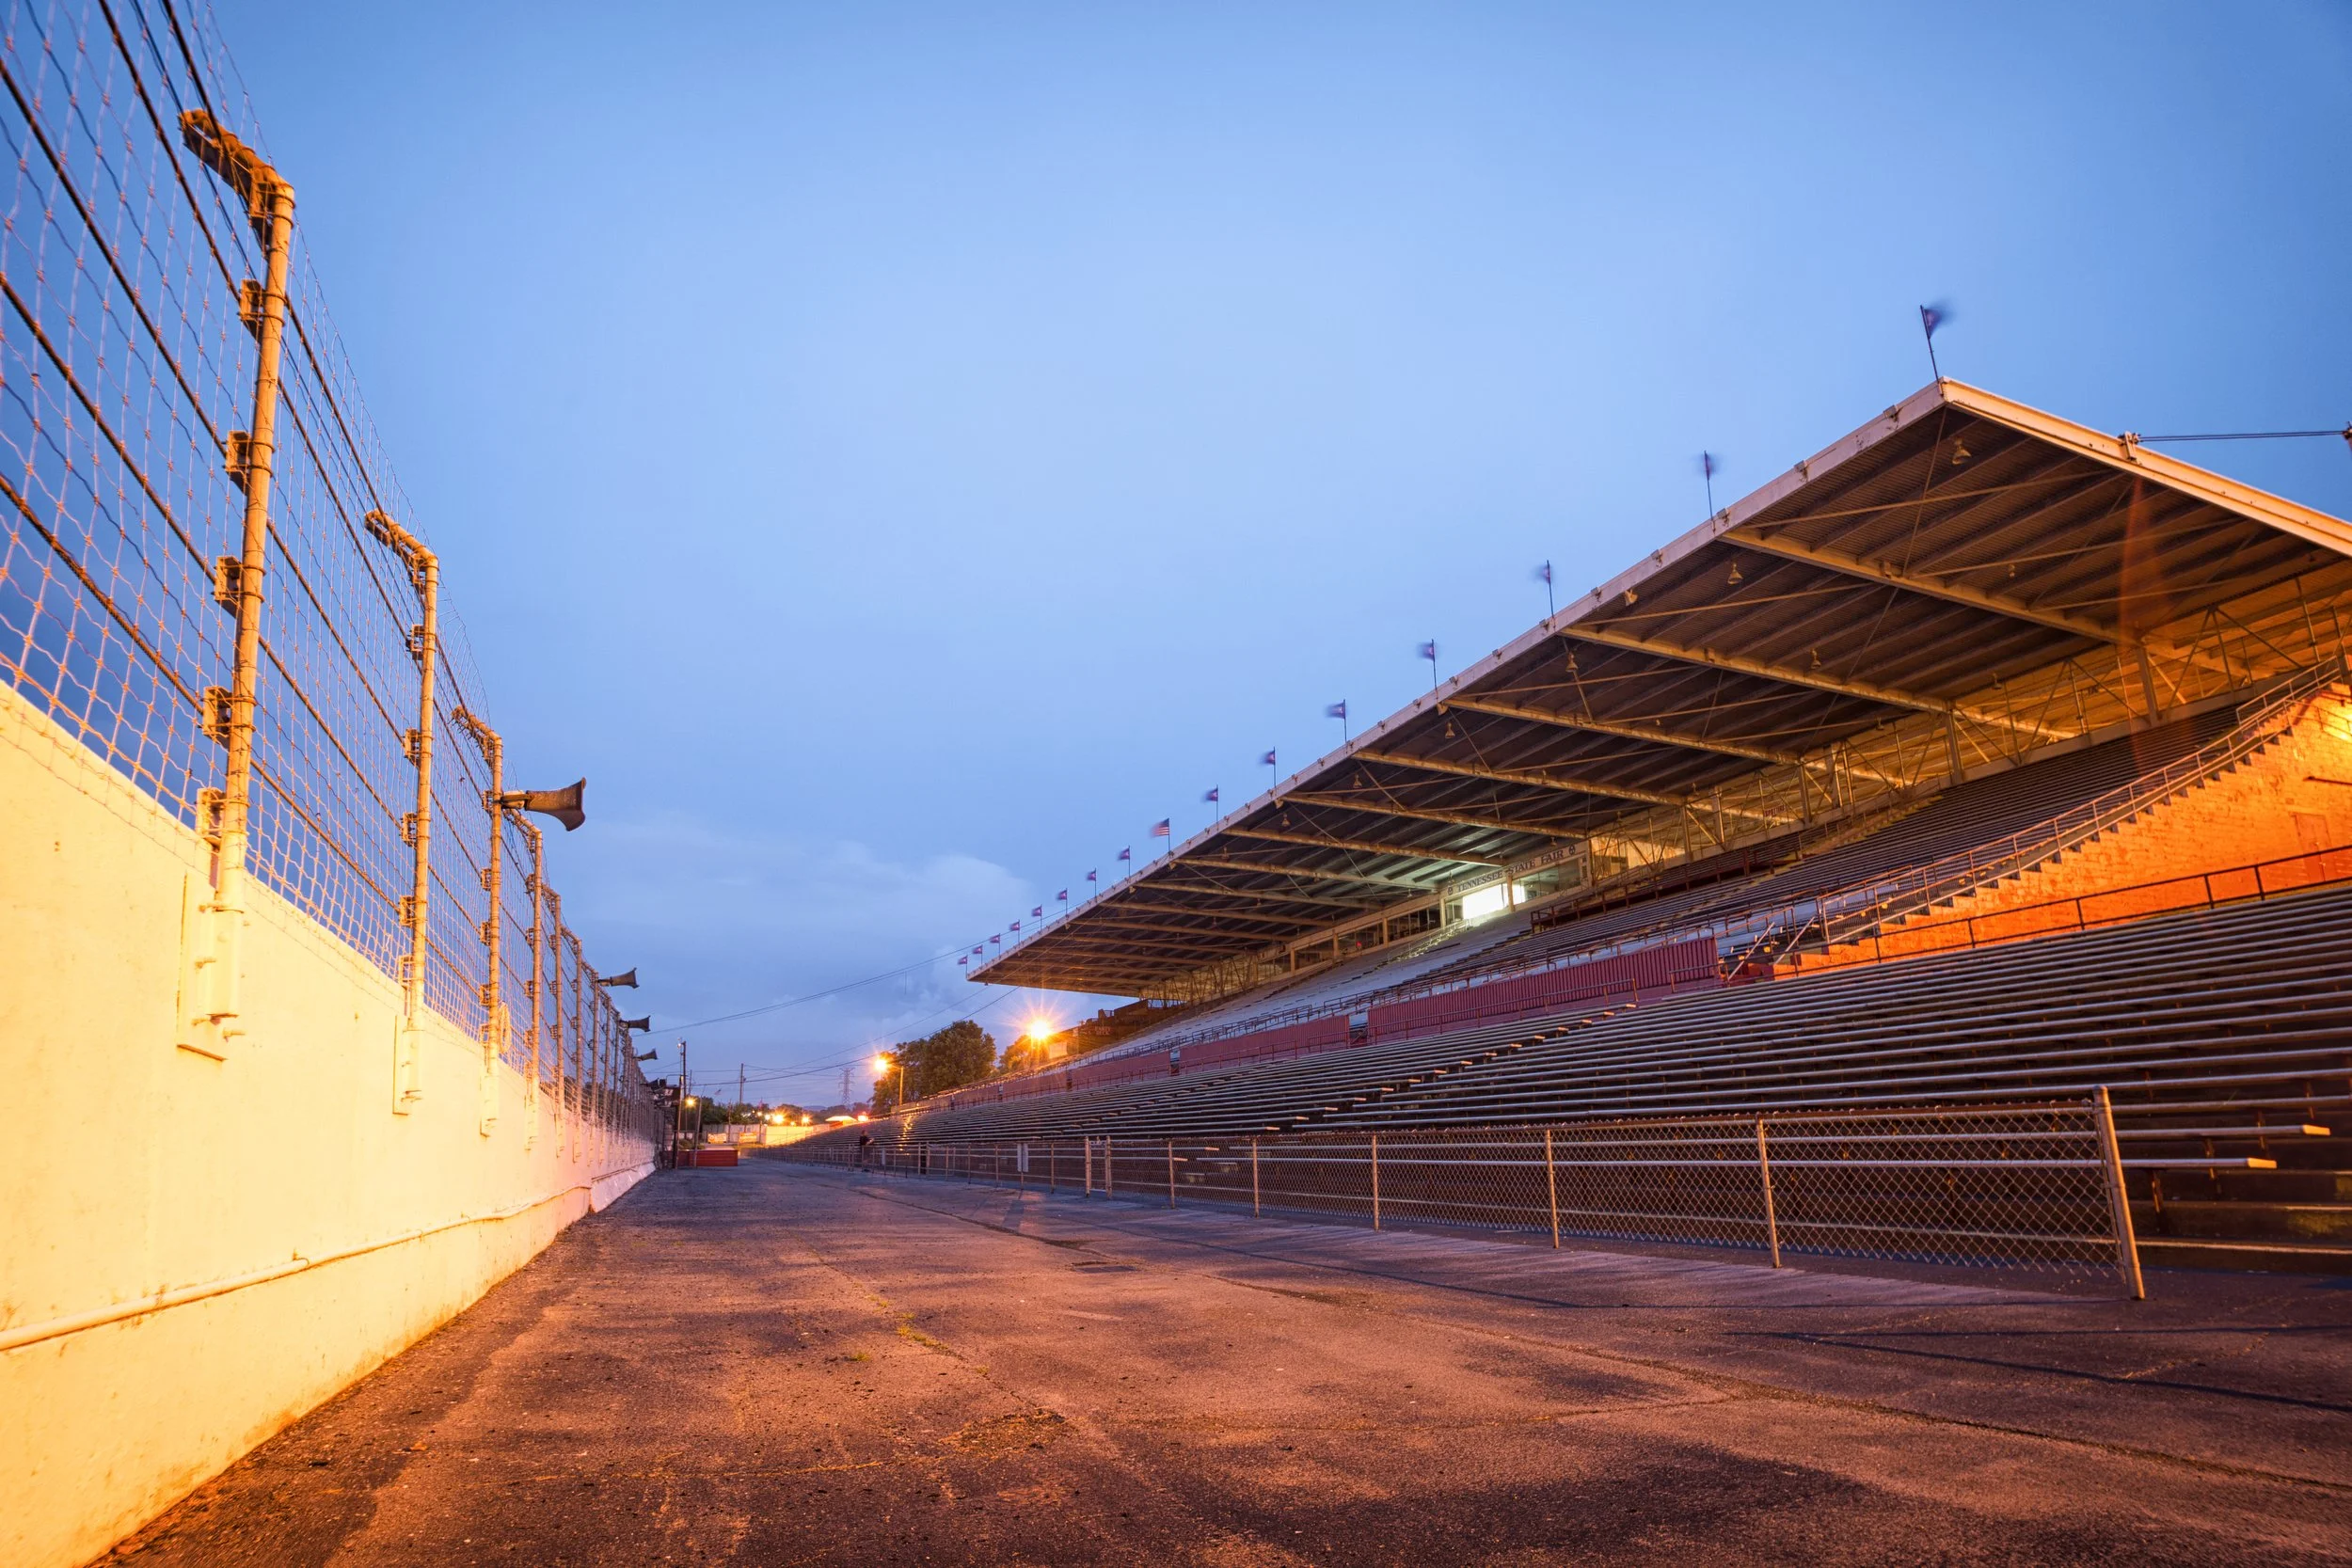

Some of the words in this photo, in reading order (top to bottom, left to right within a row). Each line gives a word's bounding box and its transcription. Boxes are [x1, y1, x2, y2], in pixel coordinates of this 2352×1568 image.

[1458, 872, 1502, 892] TENNESSEE
[1508, 860, 1535, 874] STATE
[1541, 849, 1563, 864] FAIR
